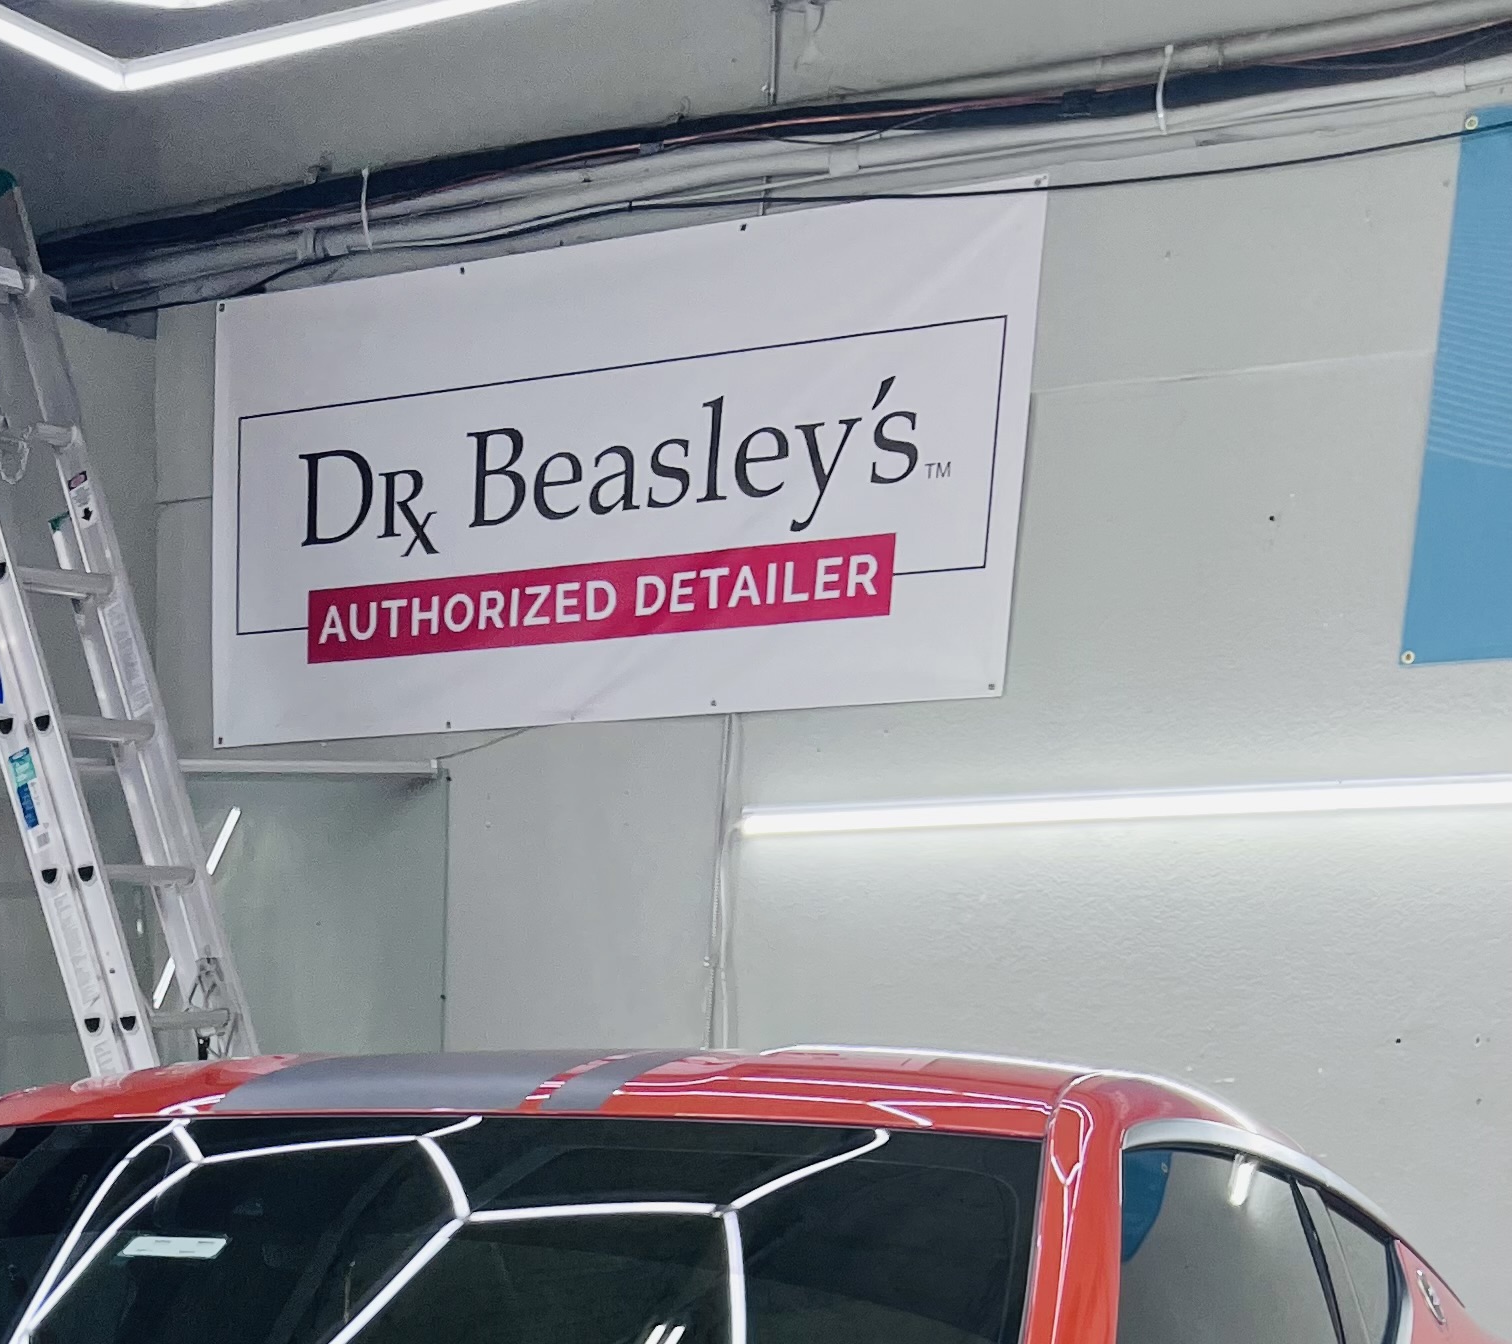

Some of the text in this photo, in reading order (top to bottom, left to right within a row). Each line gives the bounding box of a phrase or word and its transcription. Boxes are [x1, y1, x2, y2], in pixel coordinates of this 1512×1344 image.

[466, 375, 919, 533] Beasley's
[924, 461, 952, 479] TM
[317, 553, 878, 645] AUTHORIZED DETAILER
